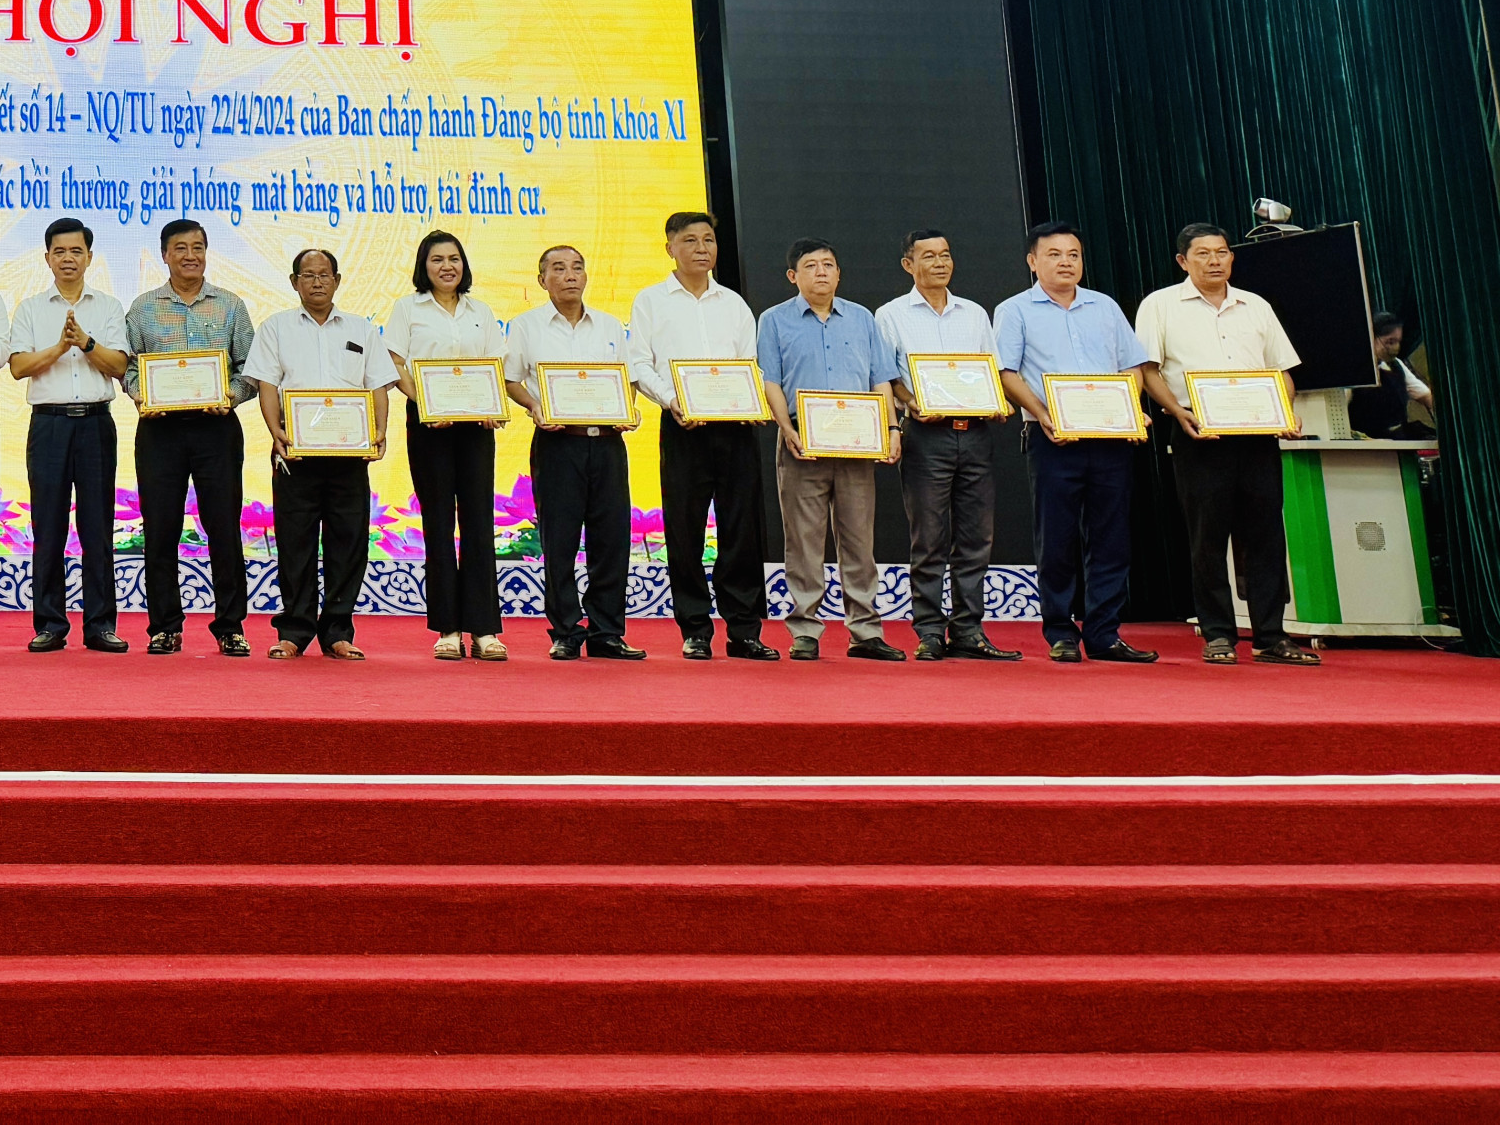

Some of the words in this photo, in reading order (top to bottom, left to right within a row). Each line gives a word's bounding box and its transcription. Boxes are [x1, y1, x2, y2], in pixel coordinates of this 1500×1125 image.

[19, 82, 41, 133] số
[45, 92, 67, 133] 14
[86, 89, 156, 144] NQ/TU
[160, 90, 206, 149] ngày
[211, 91, 296, 137] 22/4/2024
[300, 92, 333, 137] của
[337, 94, 374, 137] Ban
[378, 88, 423, 152] chấp
[427, 94, 477, 138] hành
[480, 94, 535, 154] Đảng
[537, 96, 562, 149] bộ
[611, 96, 660, 141] khóa
[663, 99, 688, 141] XI
[19, 158, 51, 209] bồi
[60, 164, 135, 225] thường,
[140, 165, 176, 225] giải
[179, 165, 243, 226] phóng
[251, 168, 288, 221] mặt
[291, 156, 341, 228] bằng
[344, 168, 367, 213] và
[371, 161, 396, 214] hỗ
[400, 175, 434, 223] trợ,
[438, 169, 463, 215] tái
[468, 171, 513, 224] định
[518, 185, 547, 216] cư.
